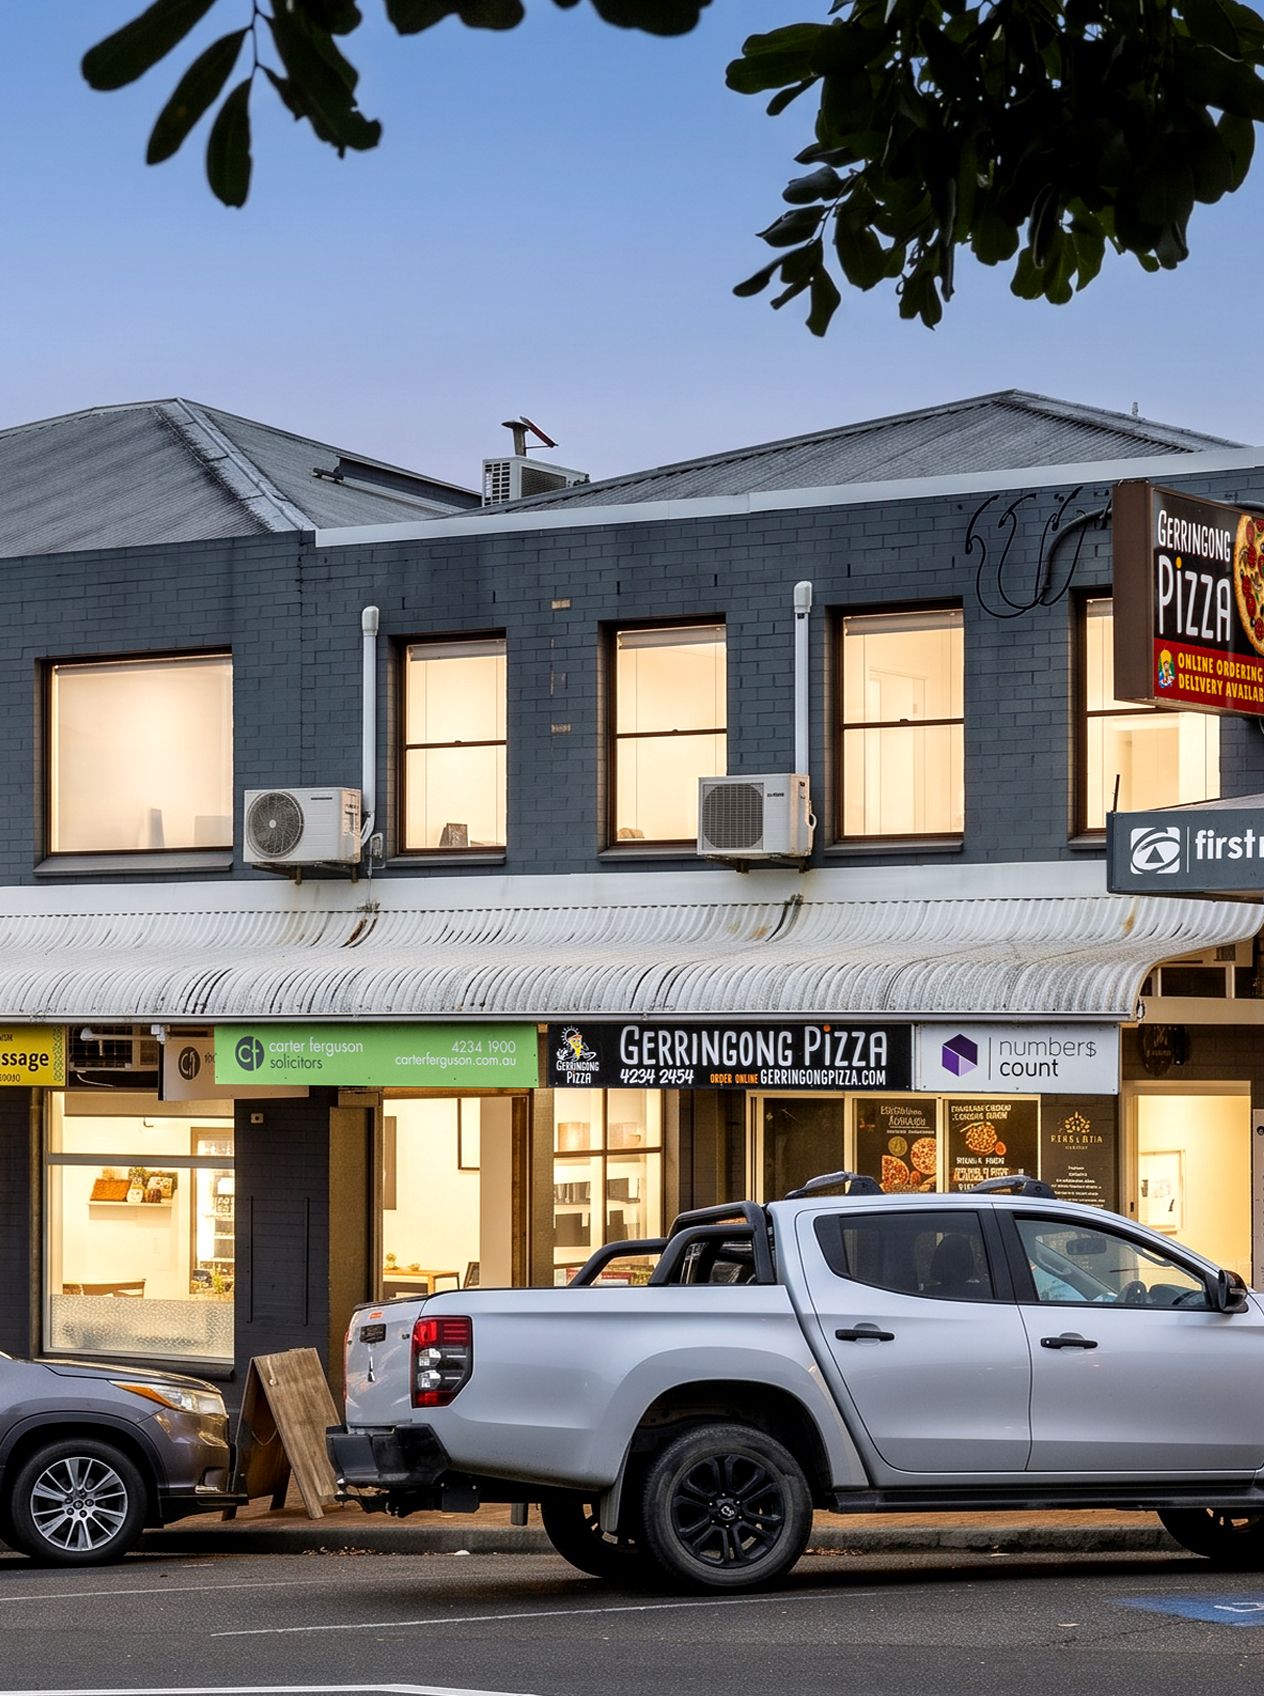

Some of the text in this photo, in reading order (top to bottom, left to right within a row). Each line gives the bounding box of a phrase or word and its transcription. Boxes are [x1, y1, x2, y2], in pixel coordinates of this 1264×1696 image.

[1158, 510, 1231, 562] GERRINGONG
[1177, 652, 1263, 682] ONLINE ORDERING
[1178, 673, 1223, 696] DELIVERY
[268, 1037, 363, 1057] carter ferguson
[451, 1040, 516, 1054] 4234 1900
[620, 1025, 792, 1066] GERRINGONG
[270, 1054, 323, 1069] solicitors
[395, 1052, 517, 1069] carterferguson.com.au
[999, 1059, 1059, 1077] count
[620, 1068, 694, 1085] 4234 2454
[710, 1069, 886, 1086] ORDER ONLINE GERRINGONGPIZZA.COM
